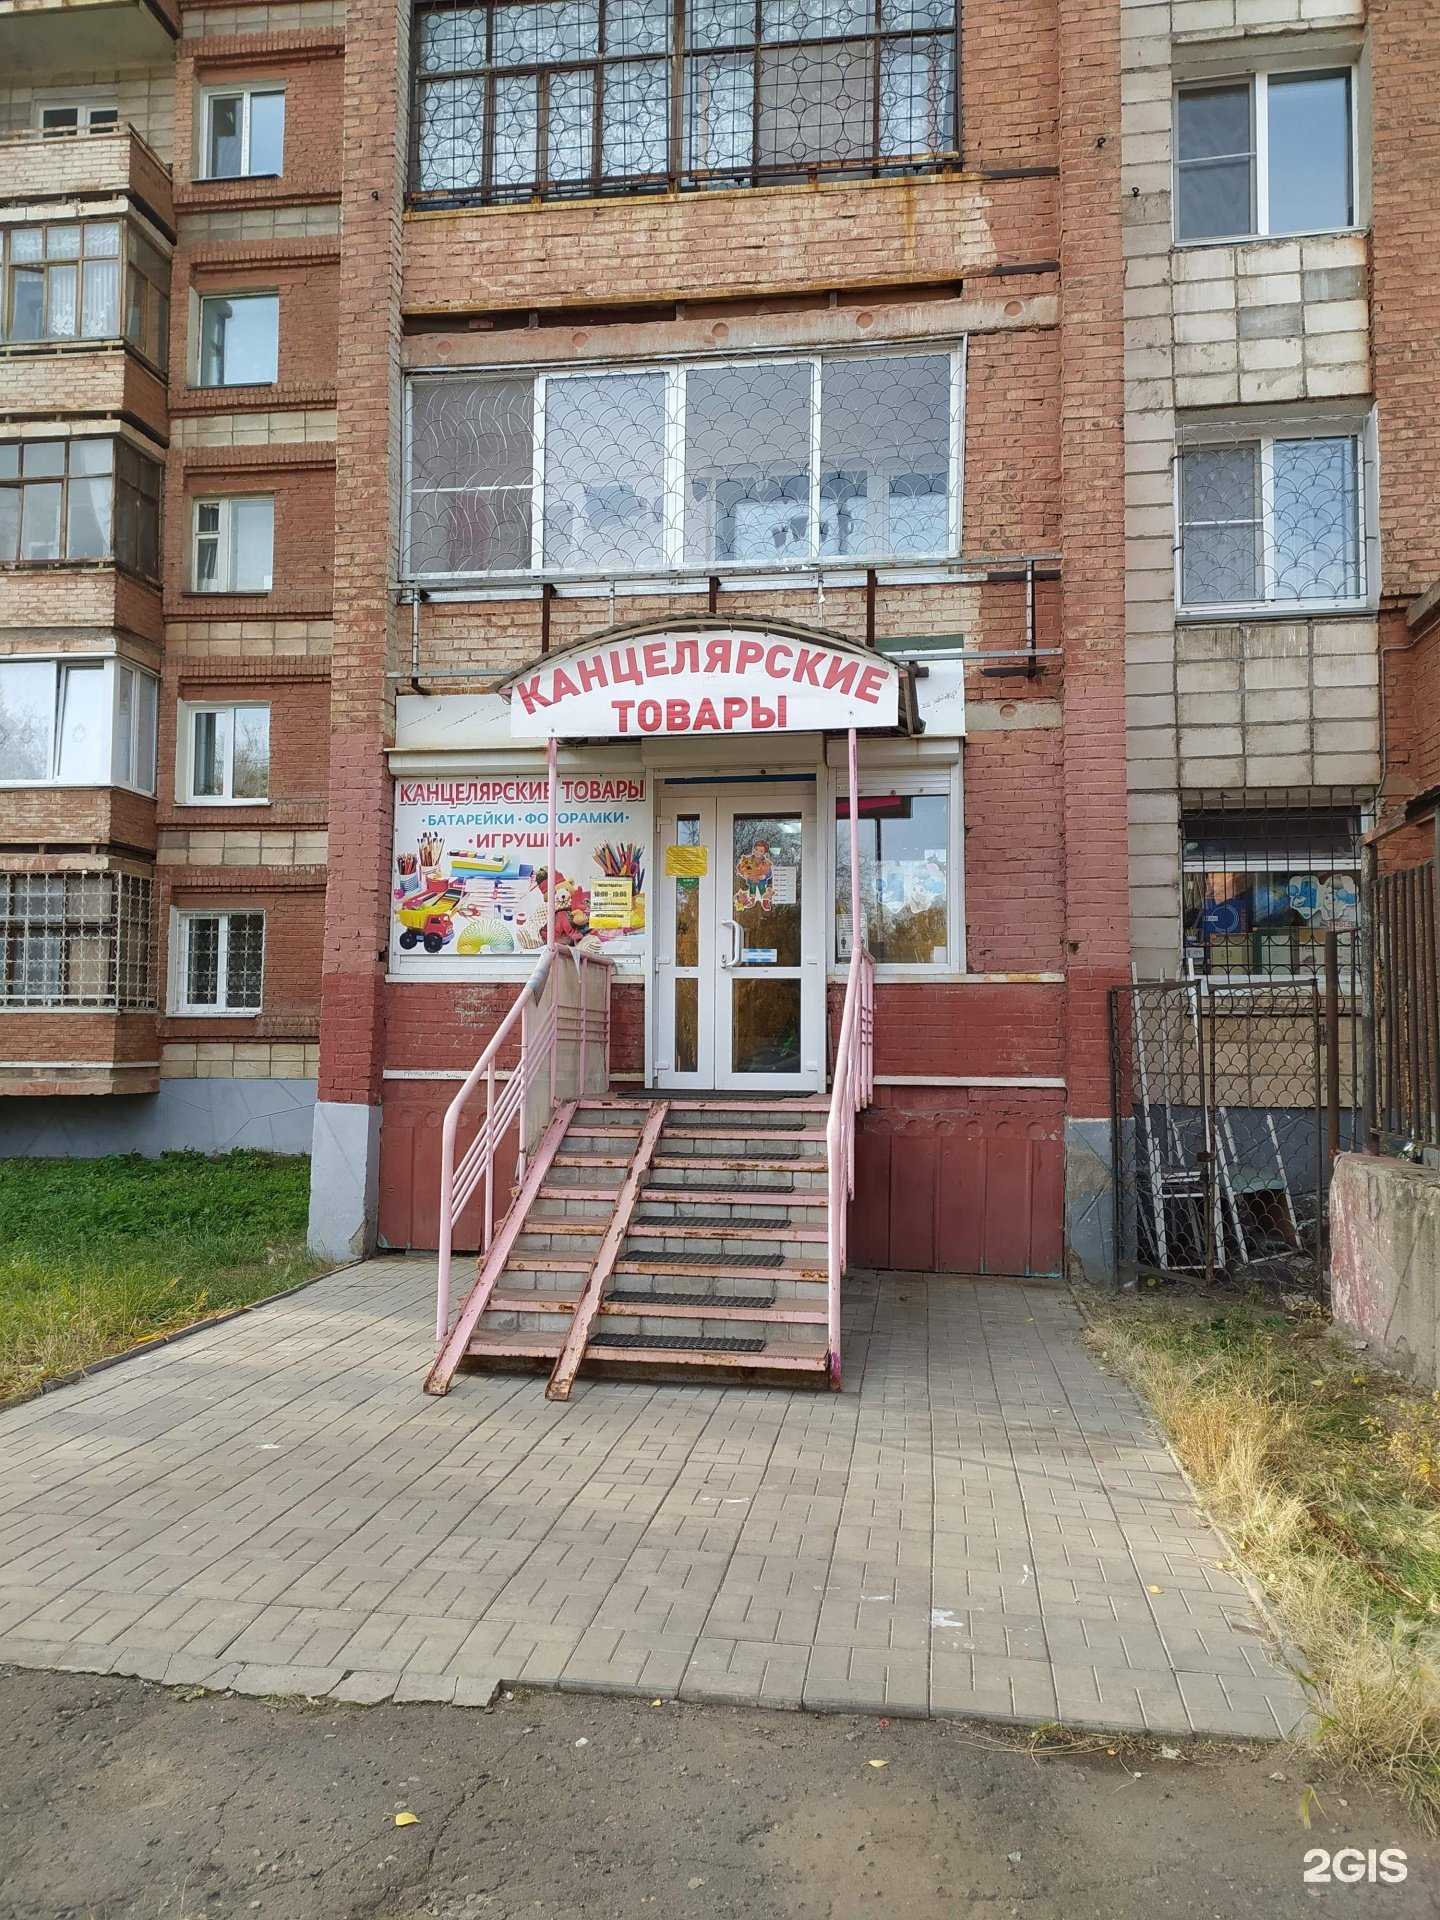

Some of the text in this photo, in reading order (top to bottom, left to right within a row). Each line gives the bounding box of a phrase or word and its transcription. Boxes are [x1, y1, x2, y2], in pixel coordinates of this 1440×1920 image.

[516, 639, 890, 715] КАНЦЕЛЯРСКИЕ
[611, 695, 787, 733] ТОВАРЫ
[400, 780, 644, 804] КАНЦЕЛЯРСКИЕ ТОВАРЫ
[428, 811, 624, 826] БАТАРЕЙКИ ФООРАМКИ
